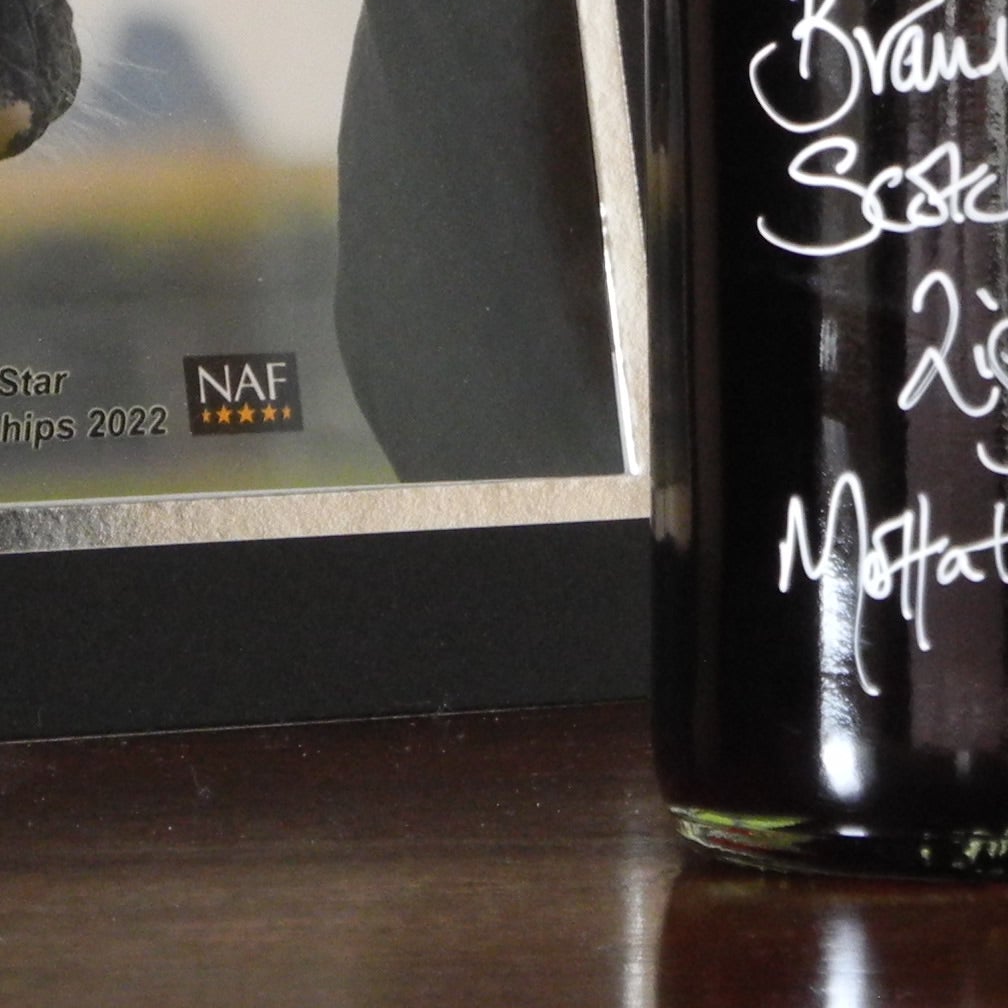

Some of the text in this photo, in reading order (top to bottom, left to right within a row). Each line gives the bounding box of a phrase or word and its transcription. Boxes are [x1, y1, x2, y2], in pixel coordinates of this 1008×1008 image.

[0, 366, 69, 397] Star
[197, 362, 287, 404] NAF
[87, 405, 169, 438] 2022
